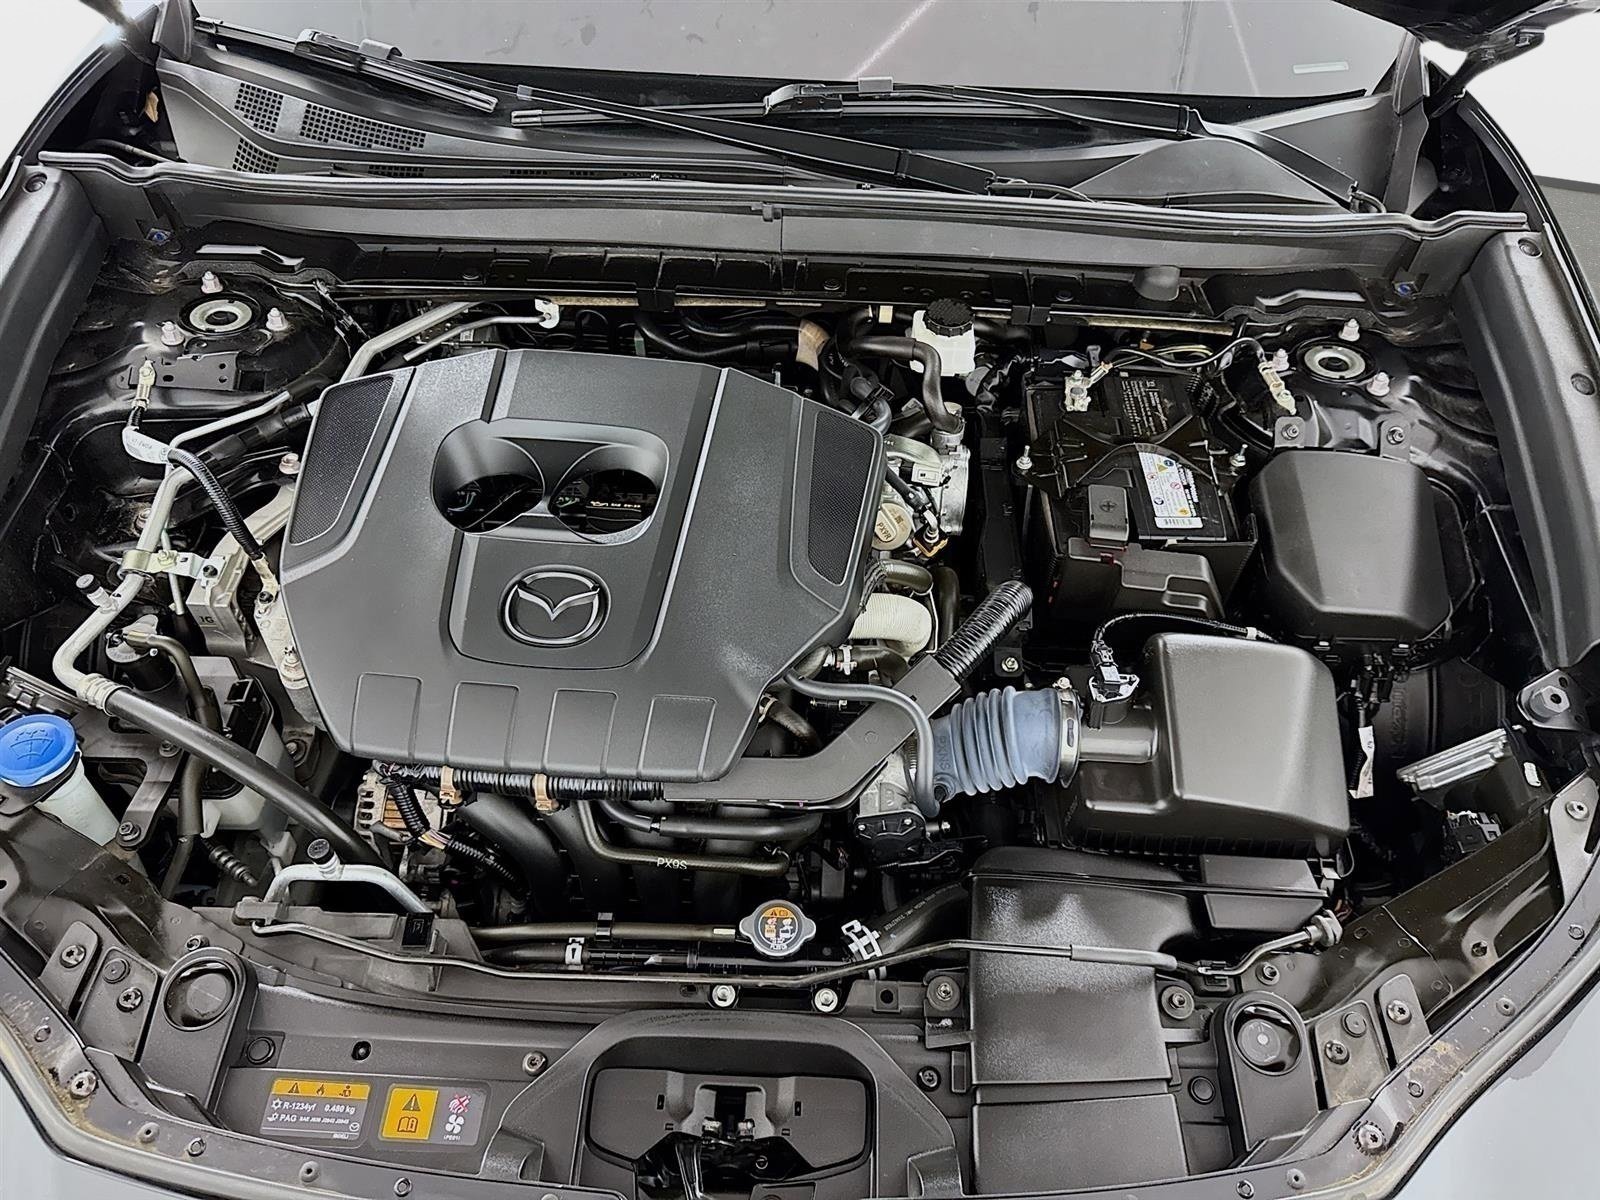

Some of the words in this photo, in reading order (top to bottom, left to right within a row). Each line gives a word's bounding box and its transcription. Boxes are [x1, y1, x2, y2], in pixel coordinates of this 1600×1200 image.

[657, 857, 688, 870] PX9S
[283, 1102, 316, 1112] R-1234yf
[345, 1105, 355, 1115] kg
[279, 1114, 297, 1122] PAG
